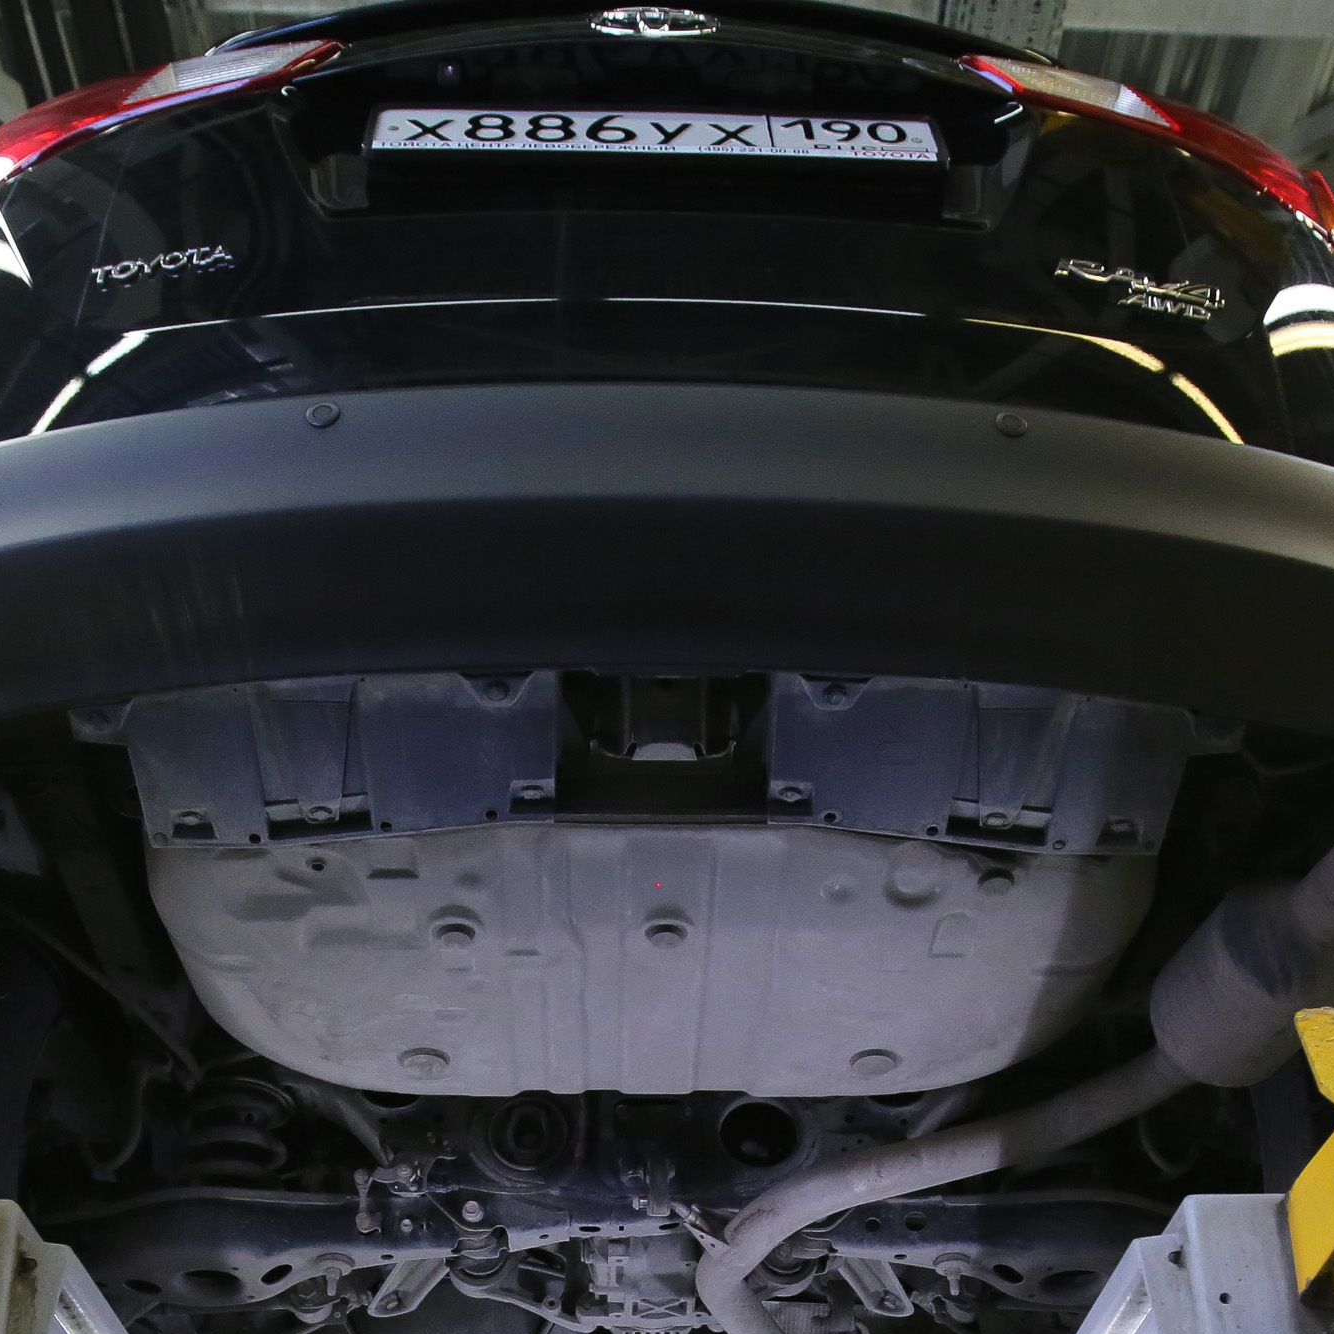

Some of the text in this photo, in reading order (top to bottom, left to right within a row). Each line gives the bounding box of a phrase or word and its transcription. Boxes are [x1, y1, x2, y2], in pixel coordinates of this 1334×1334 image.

[780, 118, 908, 144] 190
[853, 150, 931, 159] TOYOTA
[91, 244, 234, 284] TOYOTA
